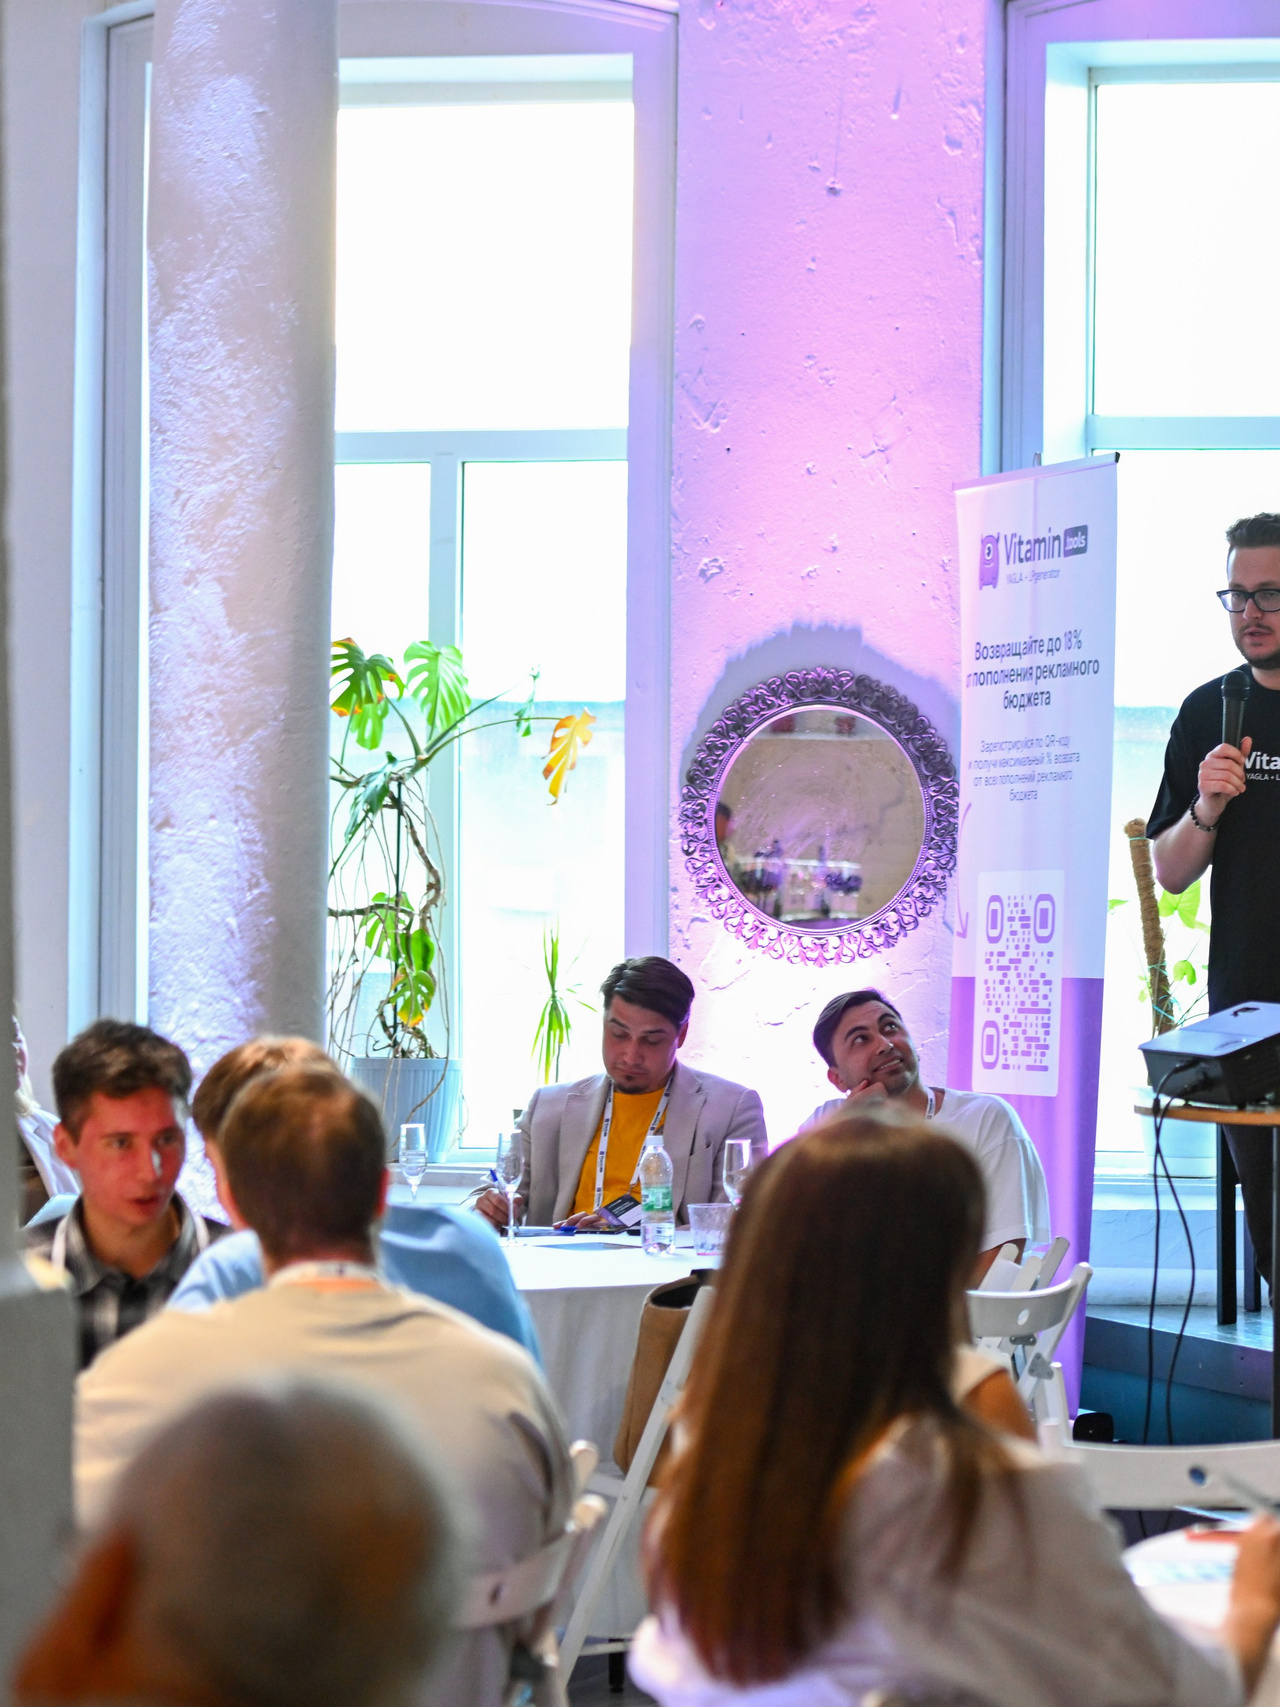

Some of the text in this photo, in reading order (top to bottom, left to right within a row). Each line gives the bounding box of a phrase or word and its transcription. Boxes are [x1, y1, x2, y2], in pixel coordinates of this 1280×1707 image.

[1004, 527, 1061, 565] Vitamin
[975, 629, 1083, 663] Возвращайте до 18%
[973, 666, 1034, 687] пополнения
[1035, 659, 1100, 685] рекламного
[1003, 690, 1051, 712] бюджета
